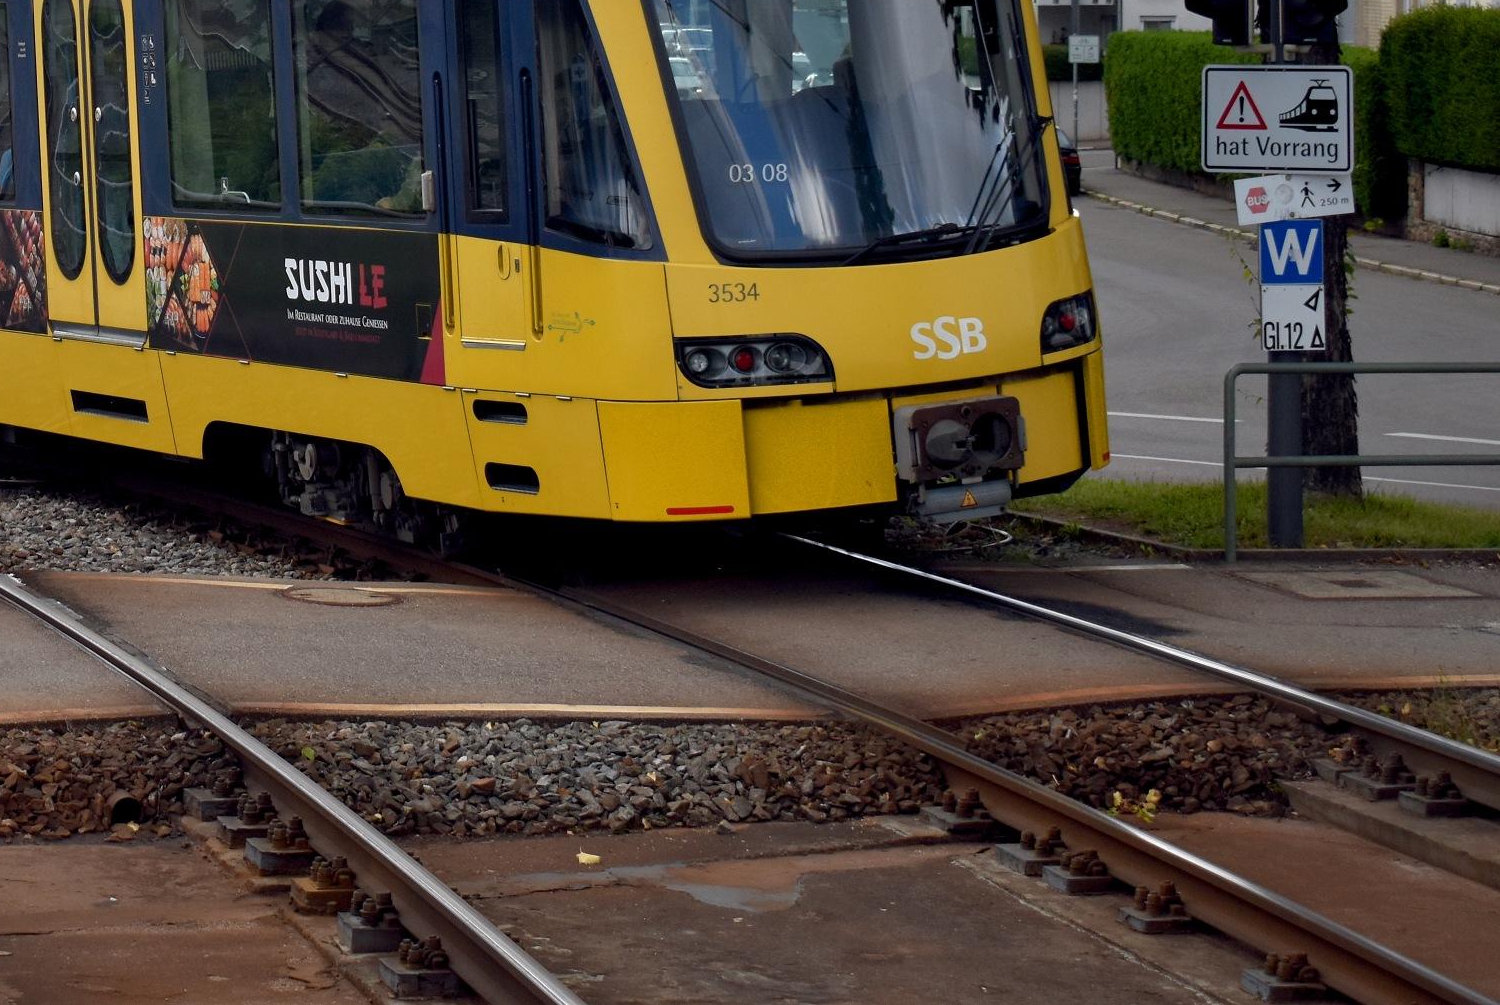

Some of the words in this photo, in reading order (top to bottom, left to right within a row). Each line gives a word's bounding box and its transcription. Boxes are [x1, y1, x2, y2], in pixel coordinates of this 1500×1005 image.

[1216, 136, 1249, 156] hat
[1256, 136, 1338, 164] Vorrang
[729, 164, 754, 183] 03
[762, 163, 788, 182] 08
[1247, 195, 1268, 206] BUS
[1320, 198, 1338, 207] 250
[1263, 228, 1319, 276] W
[284, 257, 353, 305] SUSHI
[359, 262, 388, 309] LE
[707, 282, 761, 304] 3534
[910, 316, 988, 360] SSB
